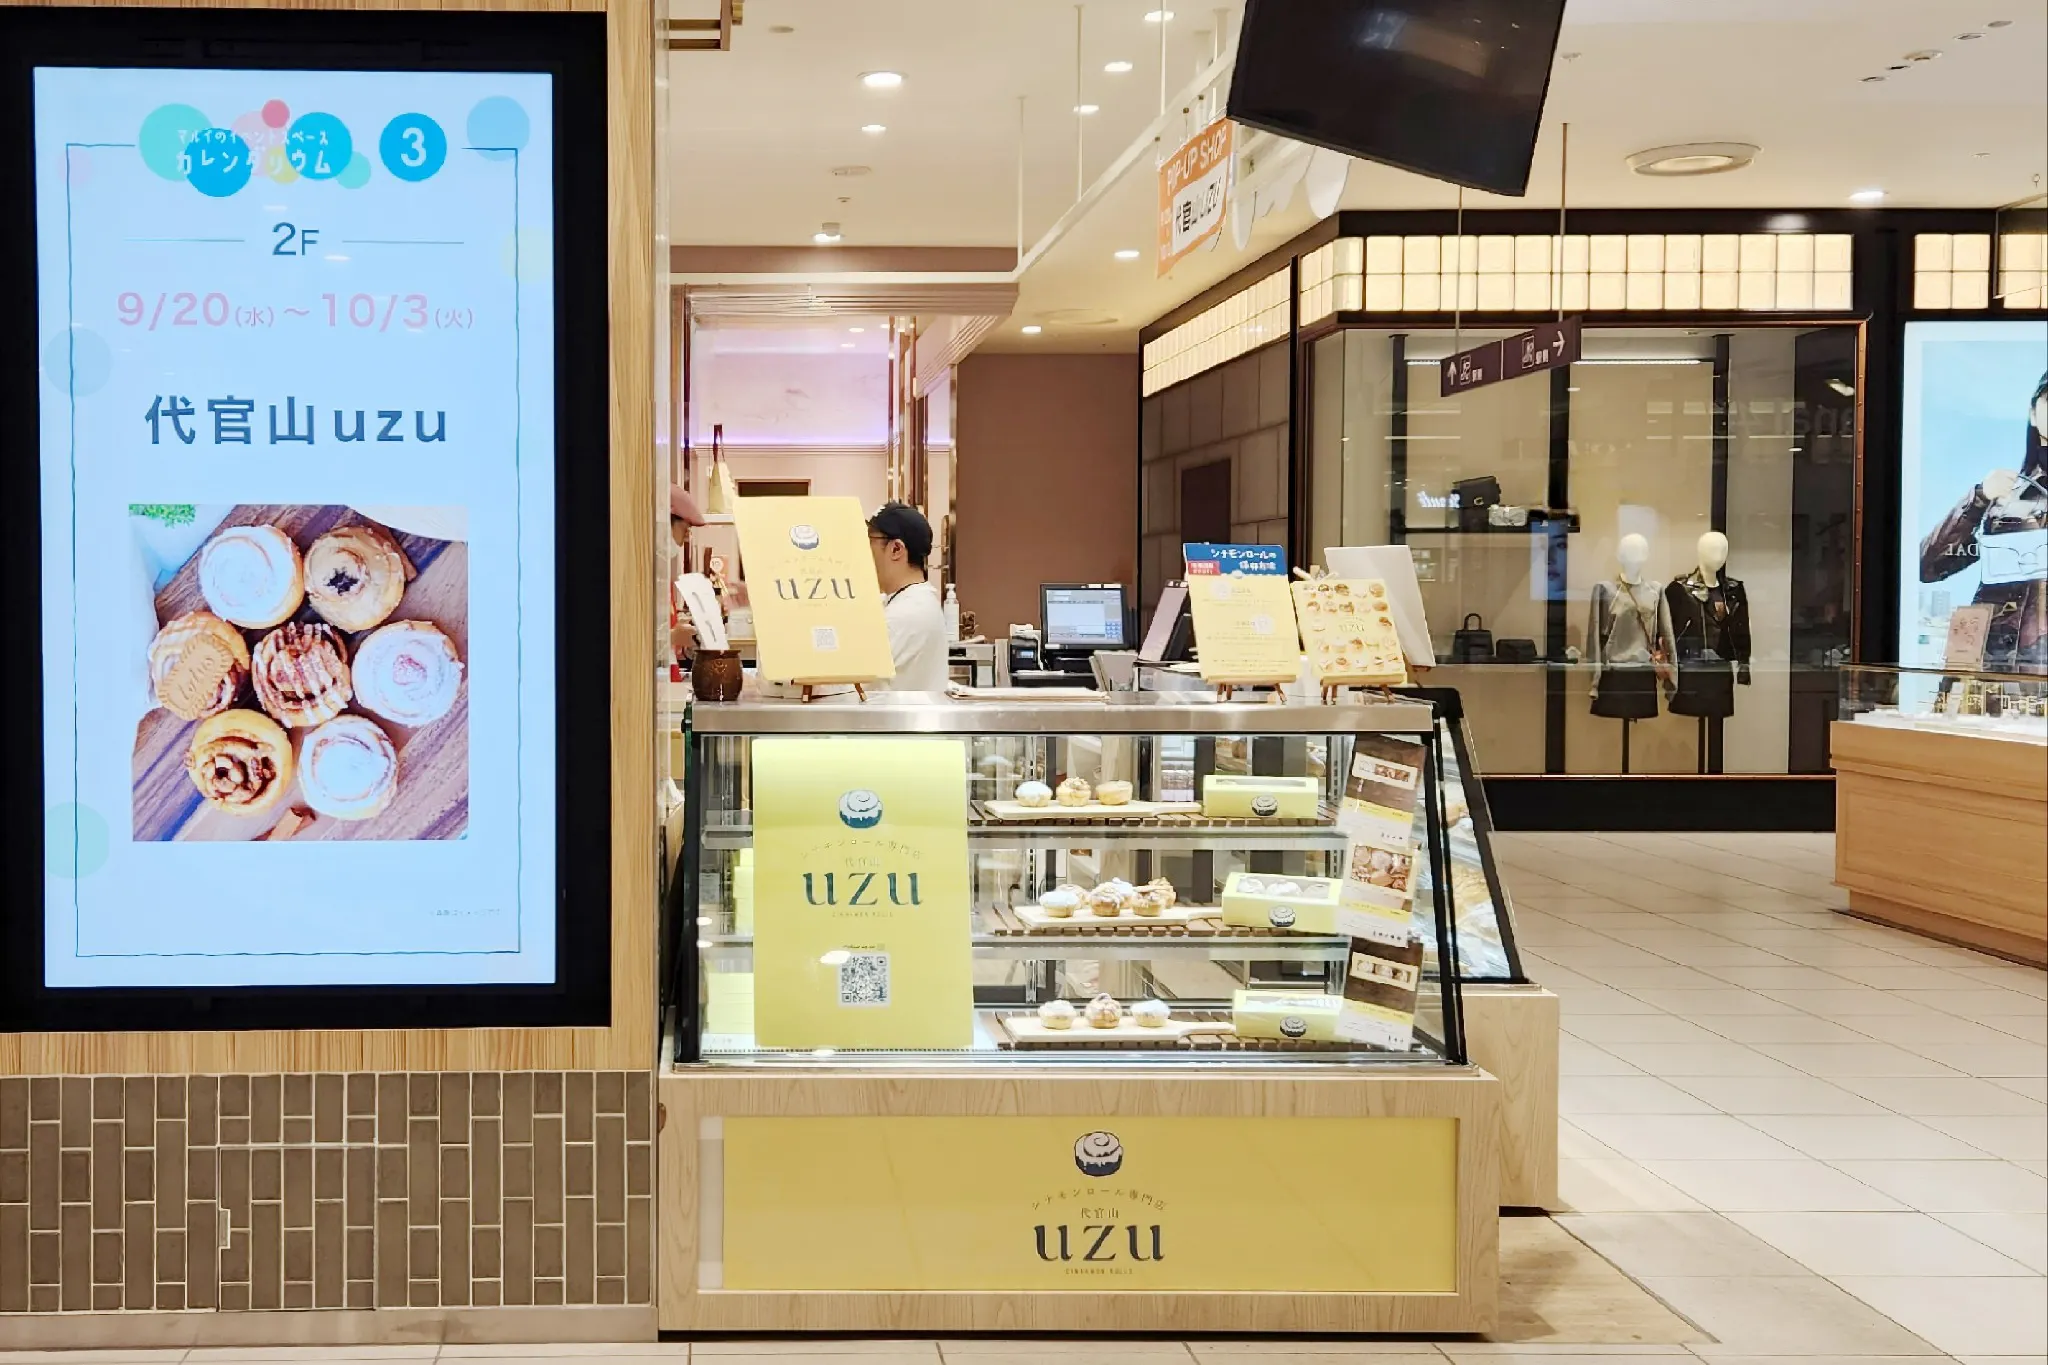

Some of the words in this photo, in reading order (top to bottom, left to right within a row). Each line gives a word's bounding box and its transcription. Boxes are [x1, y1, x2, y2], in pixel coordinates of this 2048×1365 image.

[400, 126, 428, 168] 3
[1199, 125, 1228, 171] SHOP
[272, 222, 320, 257] 2F
[773, 577, 856, 601] uzu
[802, 871, 925, 906] uzu
[1080, 1206, 1120, 1220] 代官山
[1033, 1223, 1166, 1262] uzu
